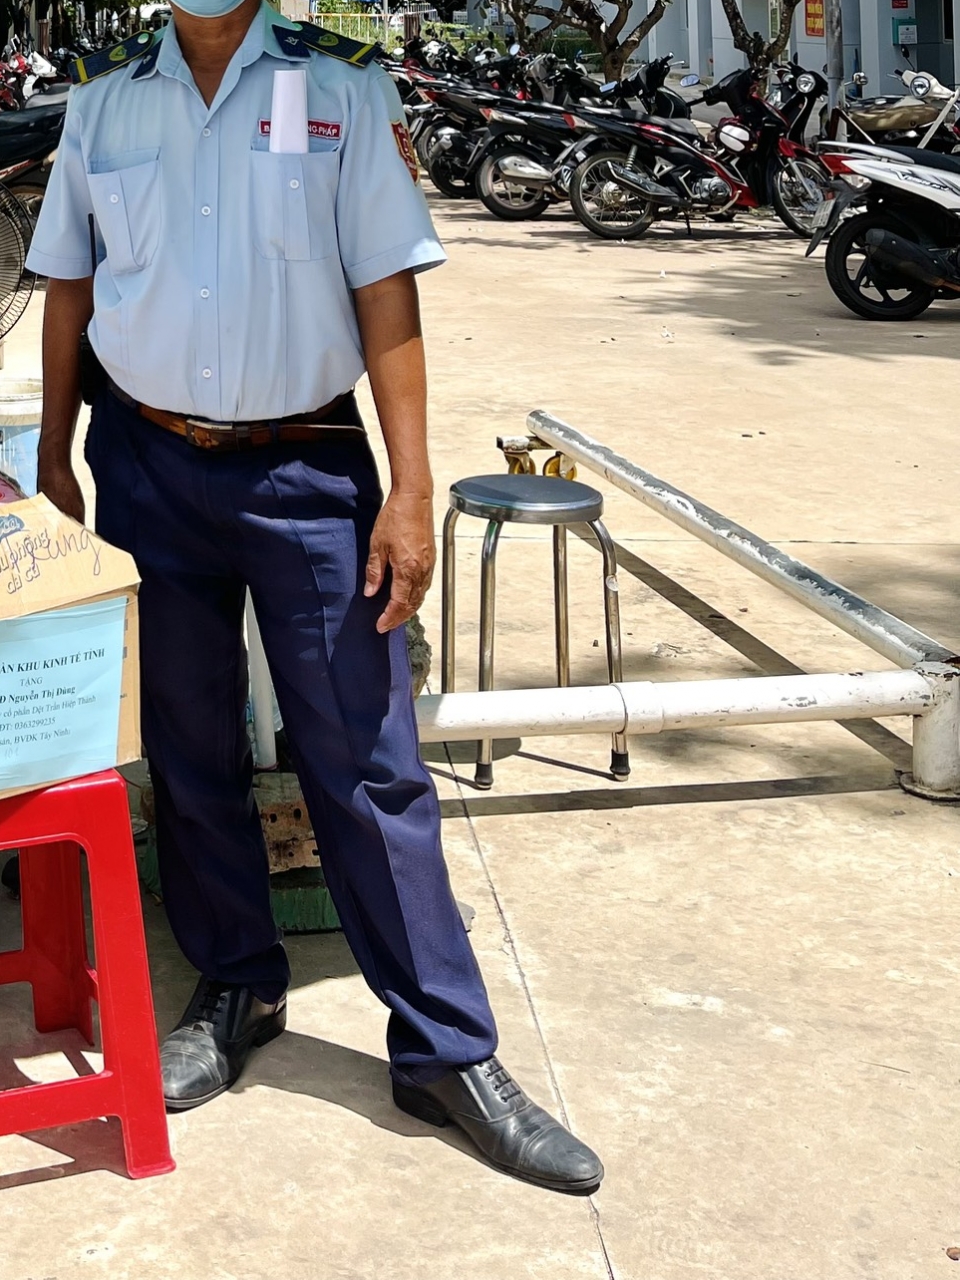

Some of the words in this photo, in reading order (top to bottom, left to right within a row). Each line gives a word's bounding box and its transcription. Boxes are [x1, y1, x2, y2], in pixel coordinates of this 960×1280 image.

[17, 660, 40, 673] KHU
[43, 656, 68, 670] KINH
[70, 651, 81, 664] TẾ
[8, 690, 39, 705] Nguyễn
[41, 688, 55, 700] Thị
